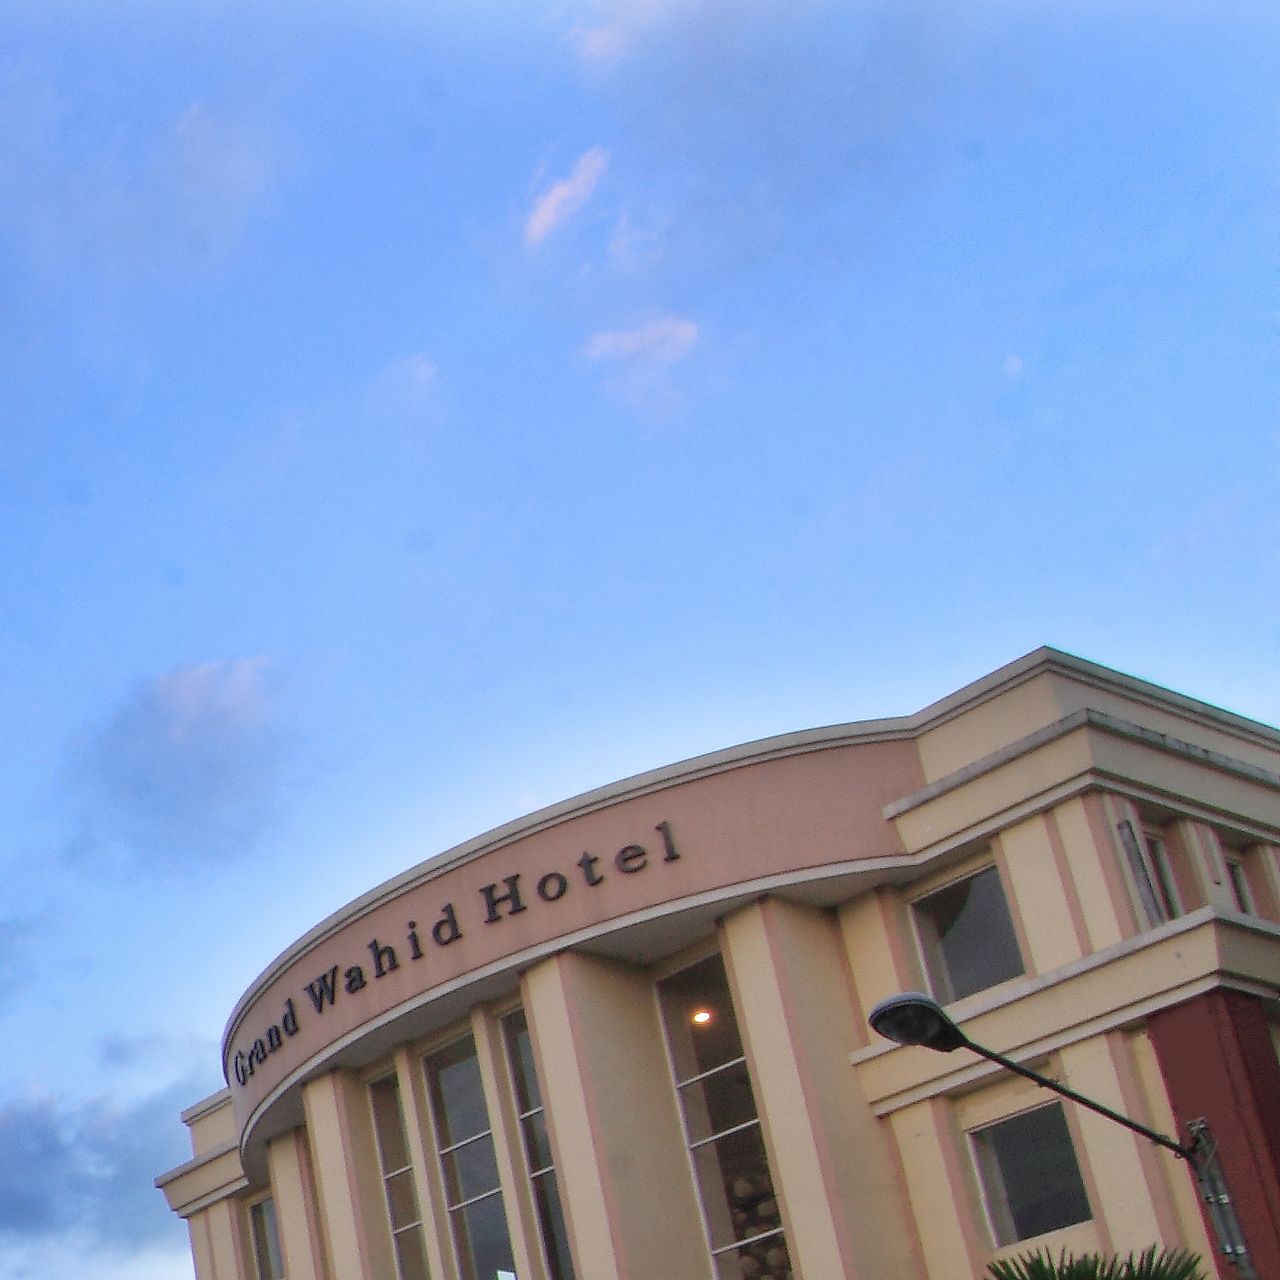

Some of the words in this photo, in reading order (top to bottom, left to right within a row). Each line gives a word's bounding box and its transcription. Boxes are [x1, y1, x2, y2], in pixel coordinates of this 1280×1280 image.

[233, 998, 300, 1087] Grand
[303, 903, 464, 1014] Wahid
[478, 820, 682, 925] Hotel
